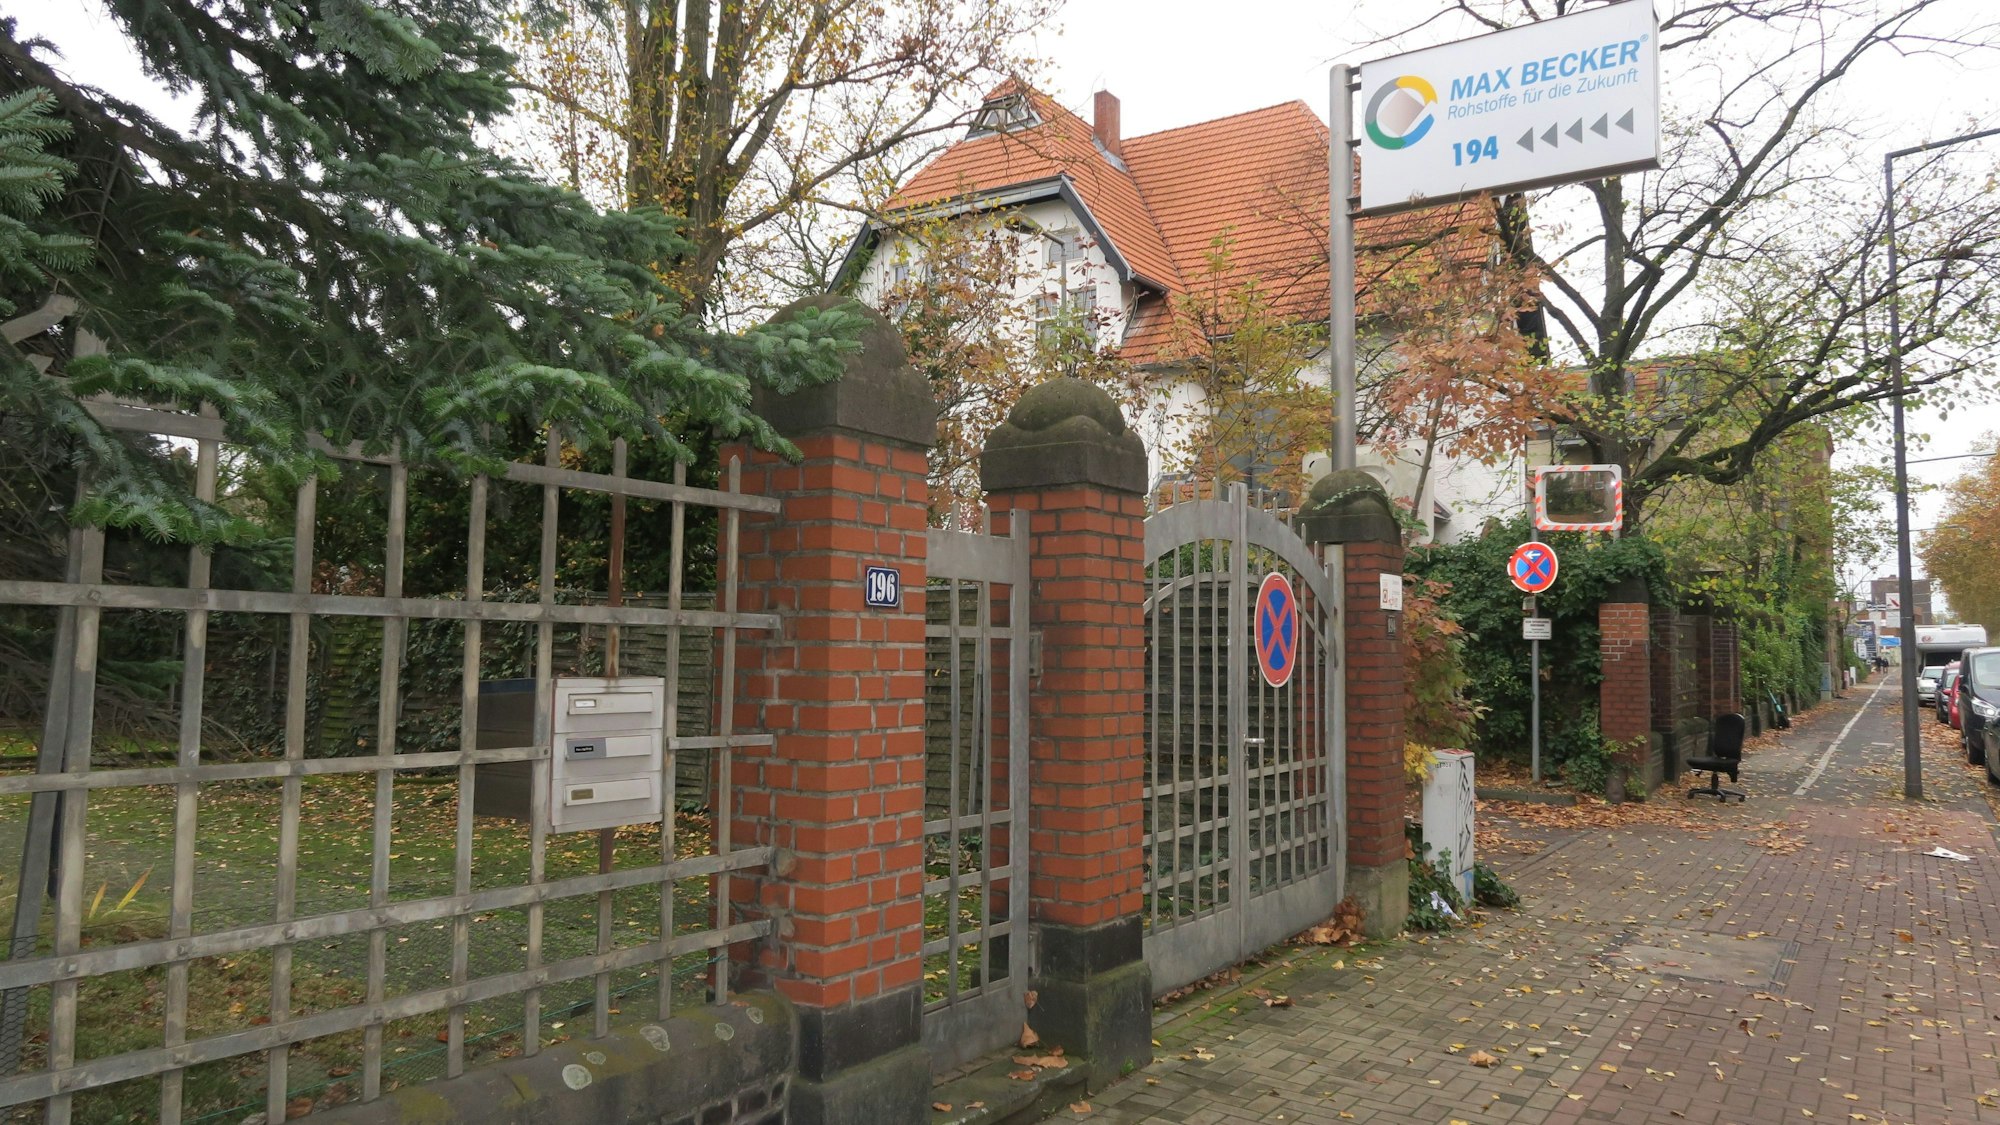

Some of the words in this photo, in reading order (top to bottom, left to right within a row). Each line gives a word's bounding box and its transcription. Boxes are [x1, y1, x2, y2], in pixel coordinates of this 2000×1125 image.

[1447, 93, 1517, 120] Rohstoffe
[1522, 88, 1544, 105] für
[1548, 83, 1572, 99] die
[1577, 68, 1639, 93] Zukunft
[1450, 66, 1512, 101] MAX
[1452, 136, 1498, 166] 194
[870, 572, 896, 602] 196
